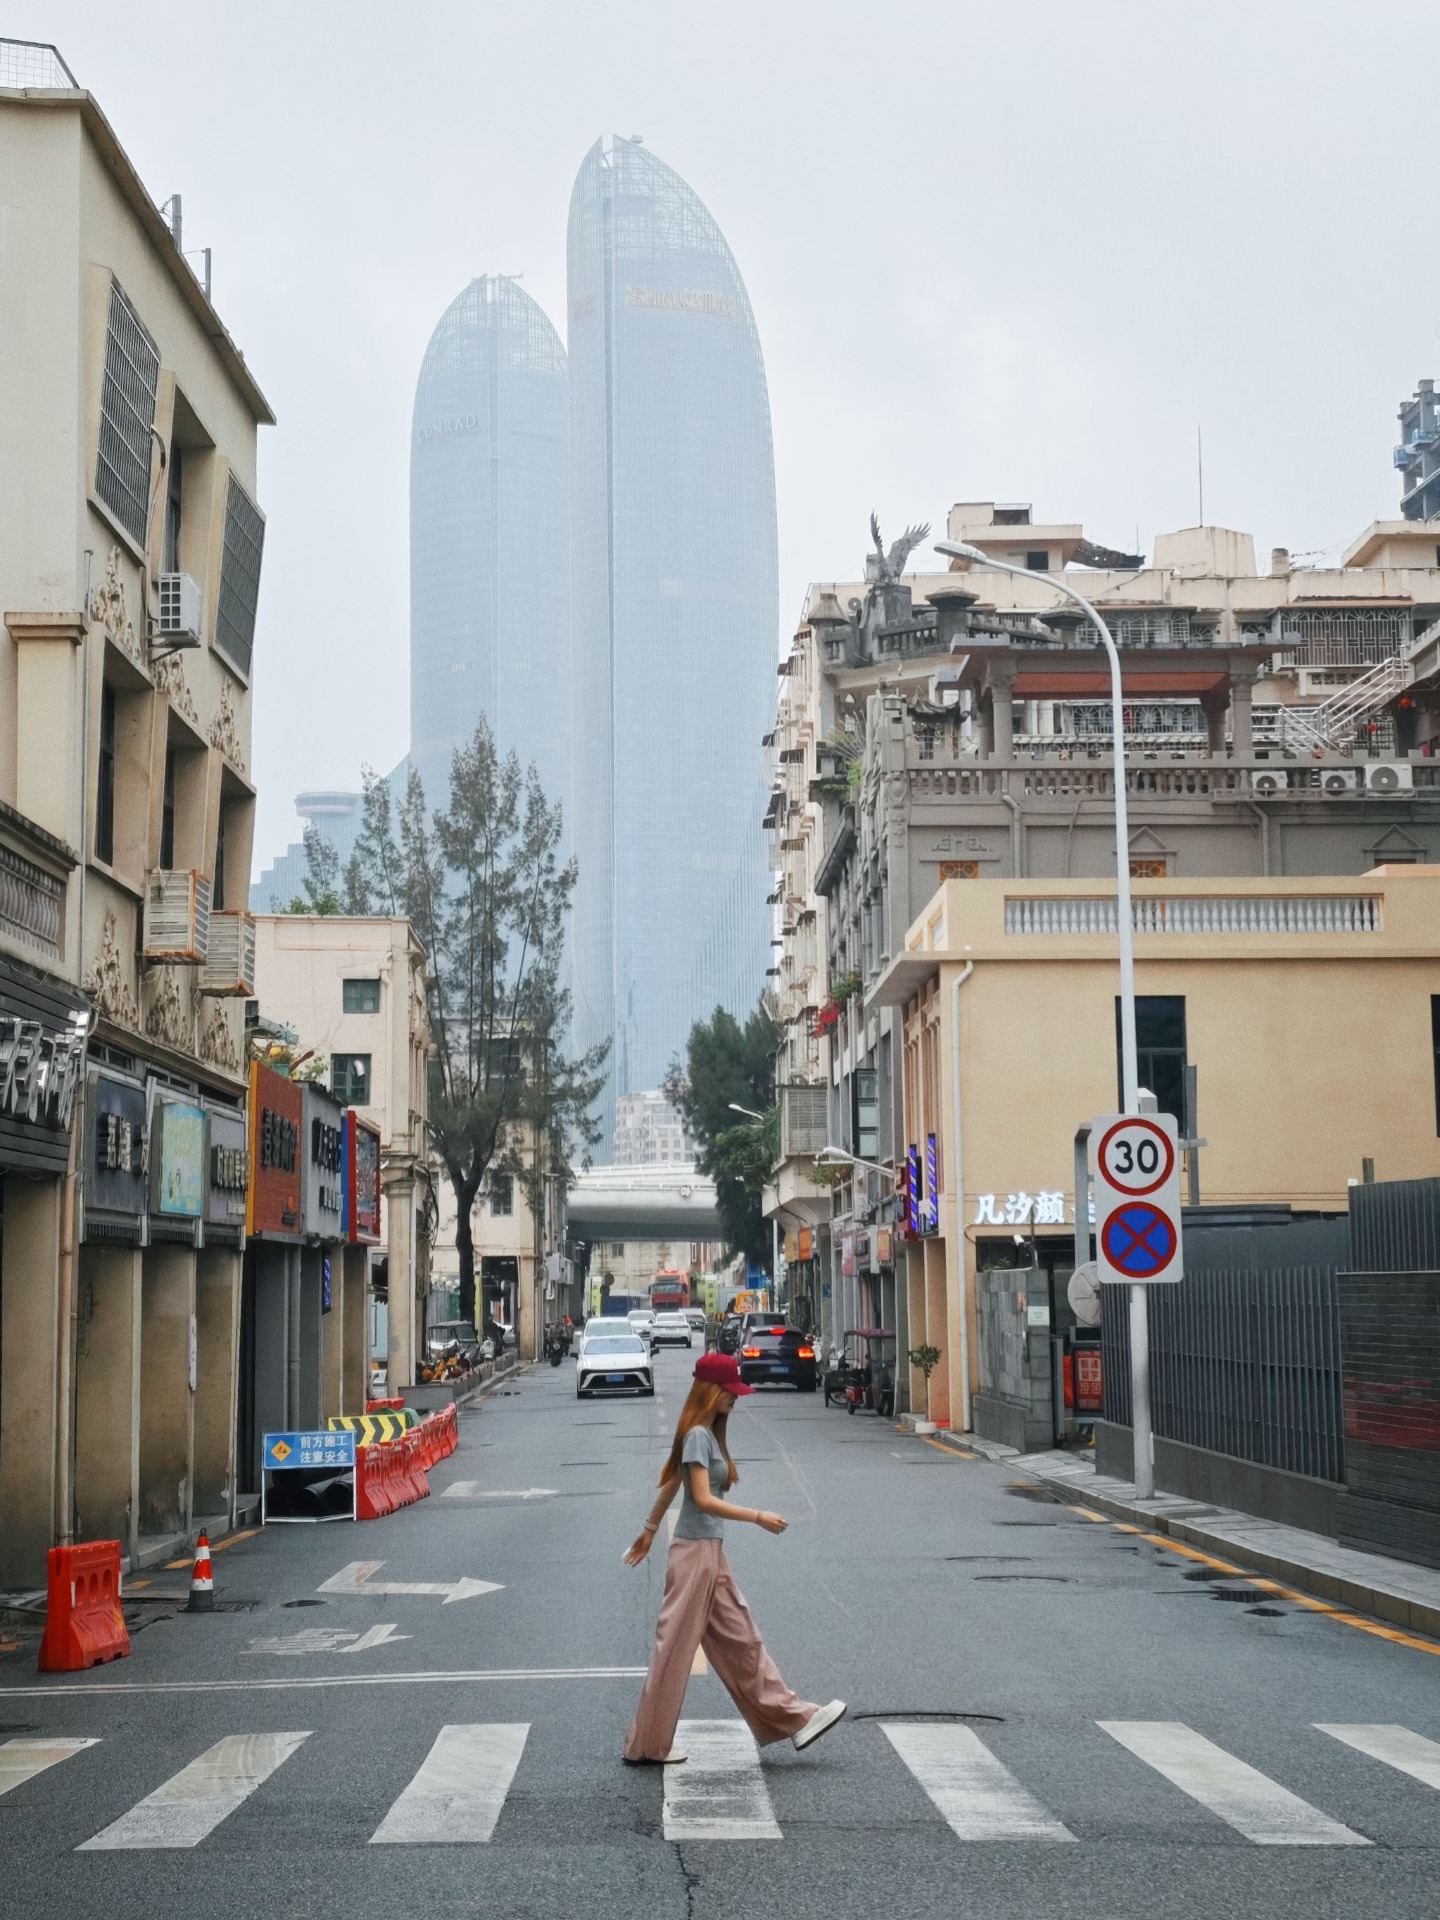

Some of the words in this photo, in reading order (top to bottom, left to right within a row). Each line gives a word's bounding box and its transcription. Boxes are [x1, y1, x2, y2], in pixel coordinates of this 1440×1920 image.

[1114, 1138, 1159, 1174] 30
[300, 1435, 348, 1449] 前方施工
[300, 1450, 348, 1464] 注意安全
